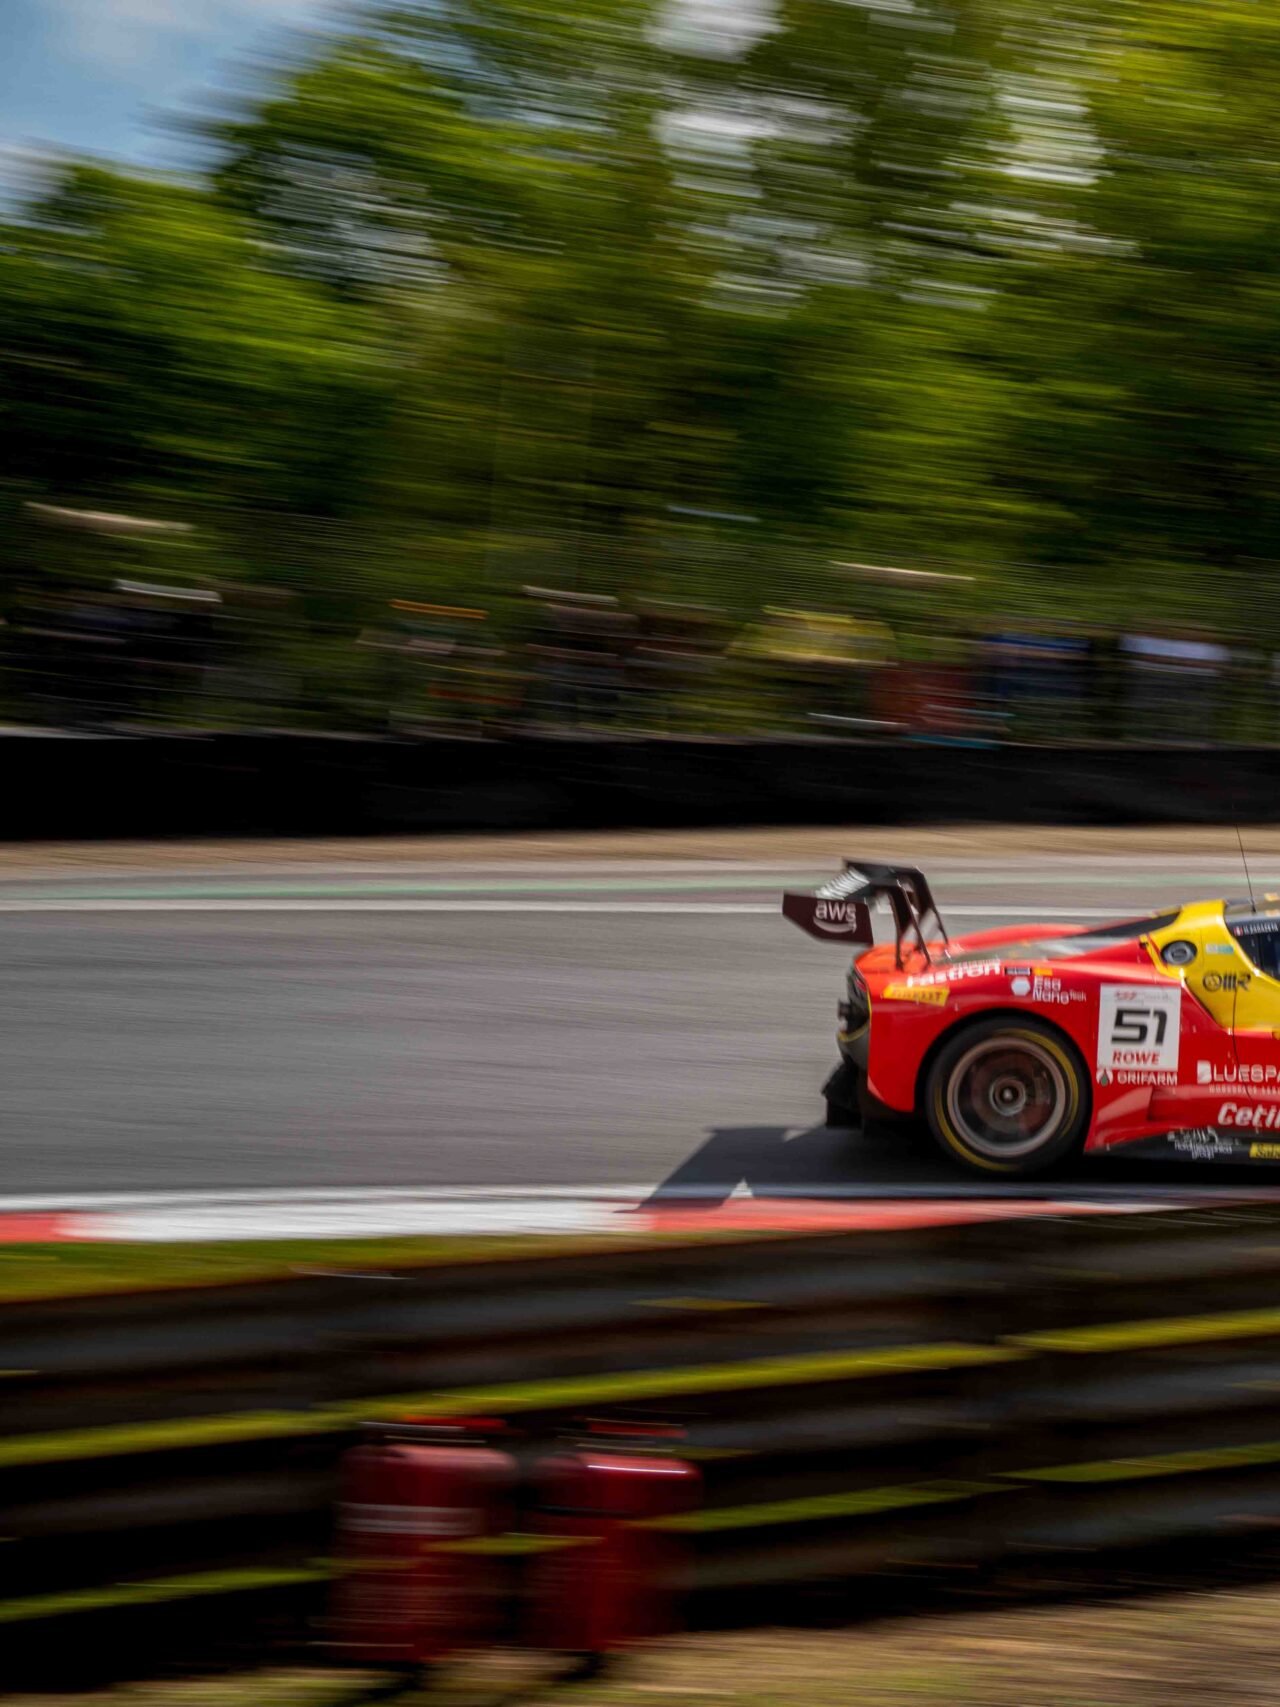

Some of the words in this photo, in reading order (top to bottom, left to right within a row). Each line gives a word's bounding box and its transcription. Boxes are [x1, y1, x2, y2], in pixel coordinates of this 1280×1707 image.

[815, 900, 858, 923] aws
[1110, 1008, 1168, 1046] 51
[1113, 1049, 1160, 1065] ROWE
